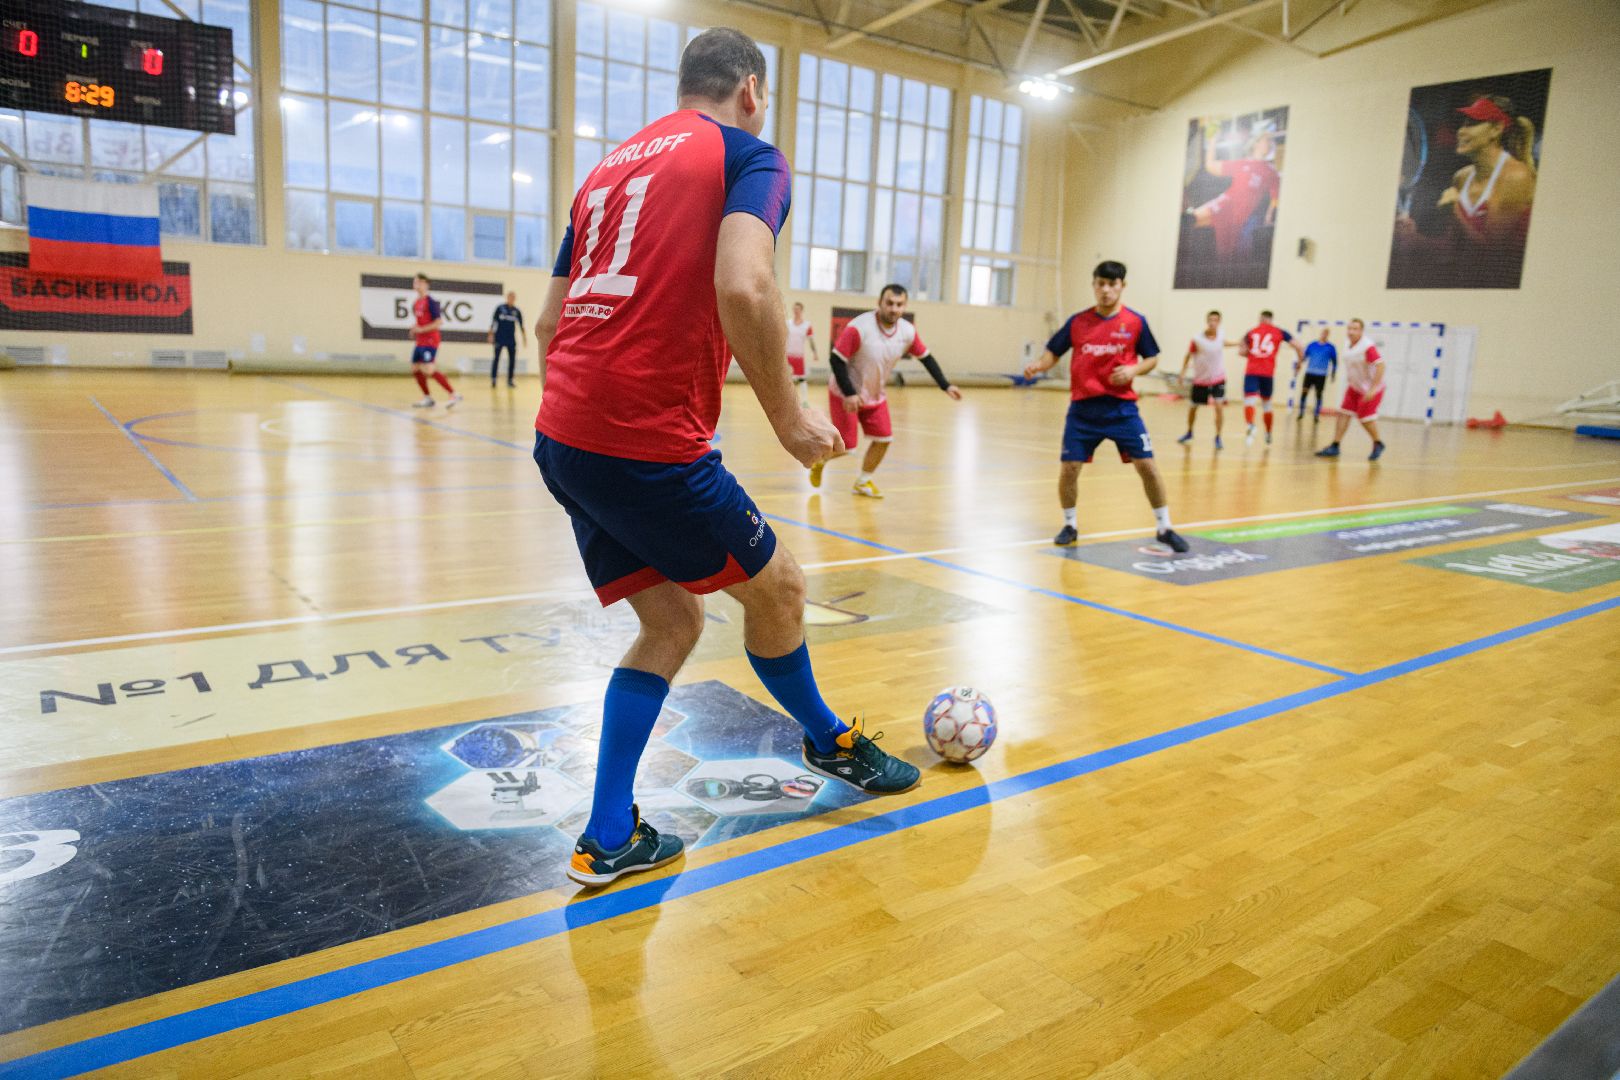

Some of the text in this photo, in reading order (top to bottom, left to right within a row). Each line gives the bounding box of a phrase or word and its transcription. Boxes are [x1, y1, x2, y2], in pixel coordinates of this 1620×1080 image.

[18, 29, 38, 57] 0
[143, 48, 163, 76] 0
[64, 81, 115, 108] 8:29
[568, 173, 655, 299] 11
[10, 276, 181, 304] БАСКЕТБОЛ
[394, 297, 473, 323] БКС
[1250, 333, 1276, 357] 16
[248, 643, 451, 689] ДЛЯ
